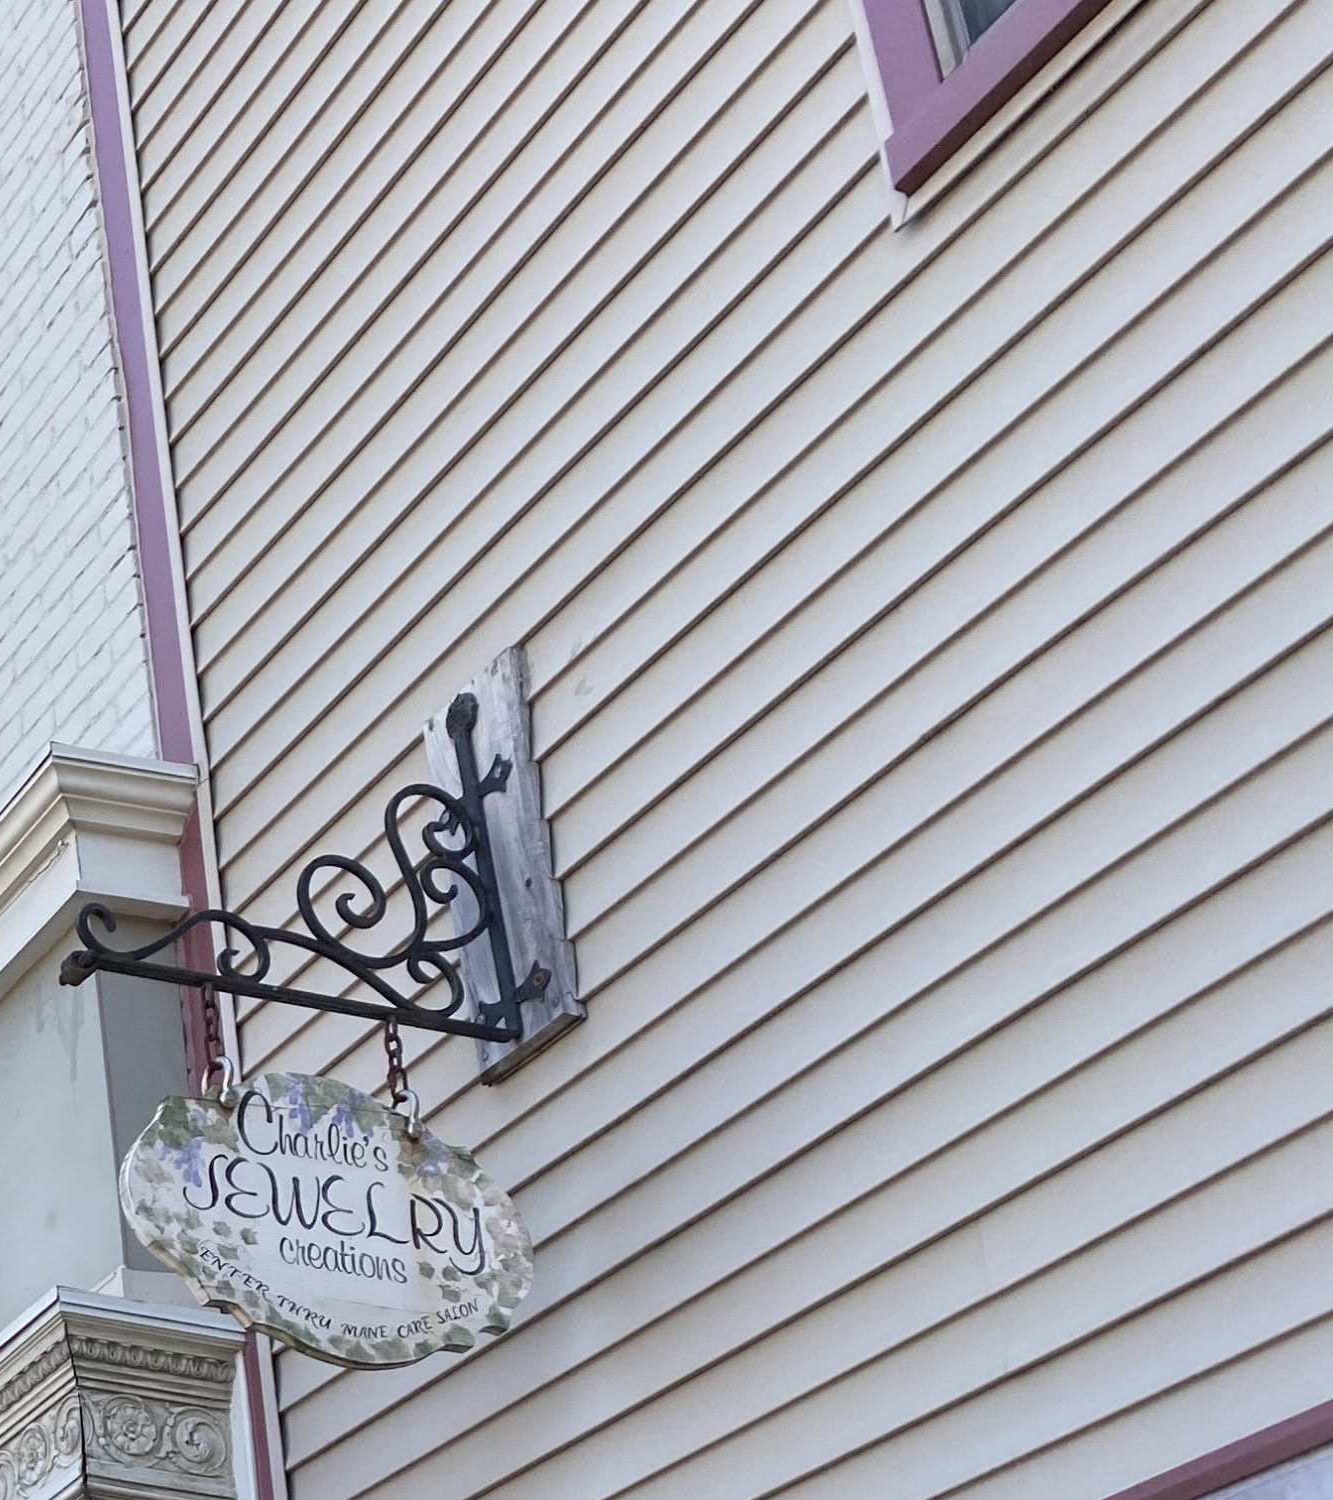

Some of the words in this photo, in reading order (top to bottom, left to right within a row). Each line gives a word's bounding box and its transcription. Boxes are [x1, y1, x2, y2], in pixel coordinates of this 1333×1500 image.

[237, 1090, 389, 1172] Charlie's
[183, 1154, 485, 1275] JEWELRY
[200, 1245, 273, 1302] ENTER
[277, 1294, 332, 1328] THRU
[341, 1323, 391, 1339] MANE
[397, 1315, 433, 1339] CARE
[436, 1300, 480, 1326] SALON
[279, 1236, 408, 1284] creations
